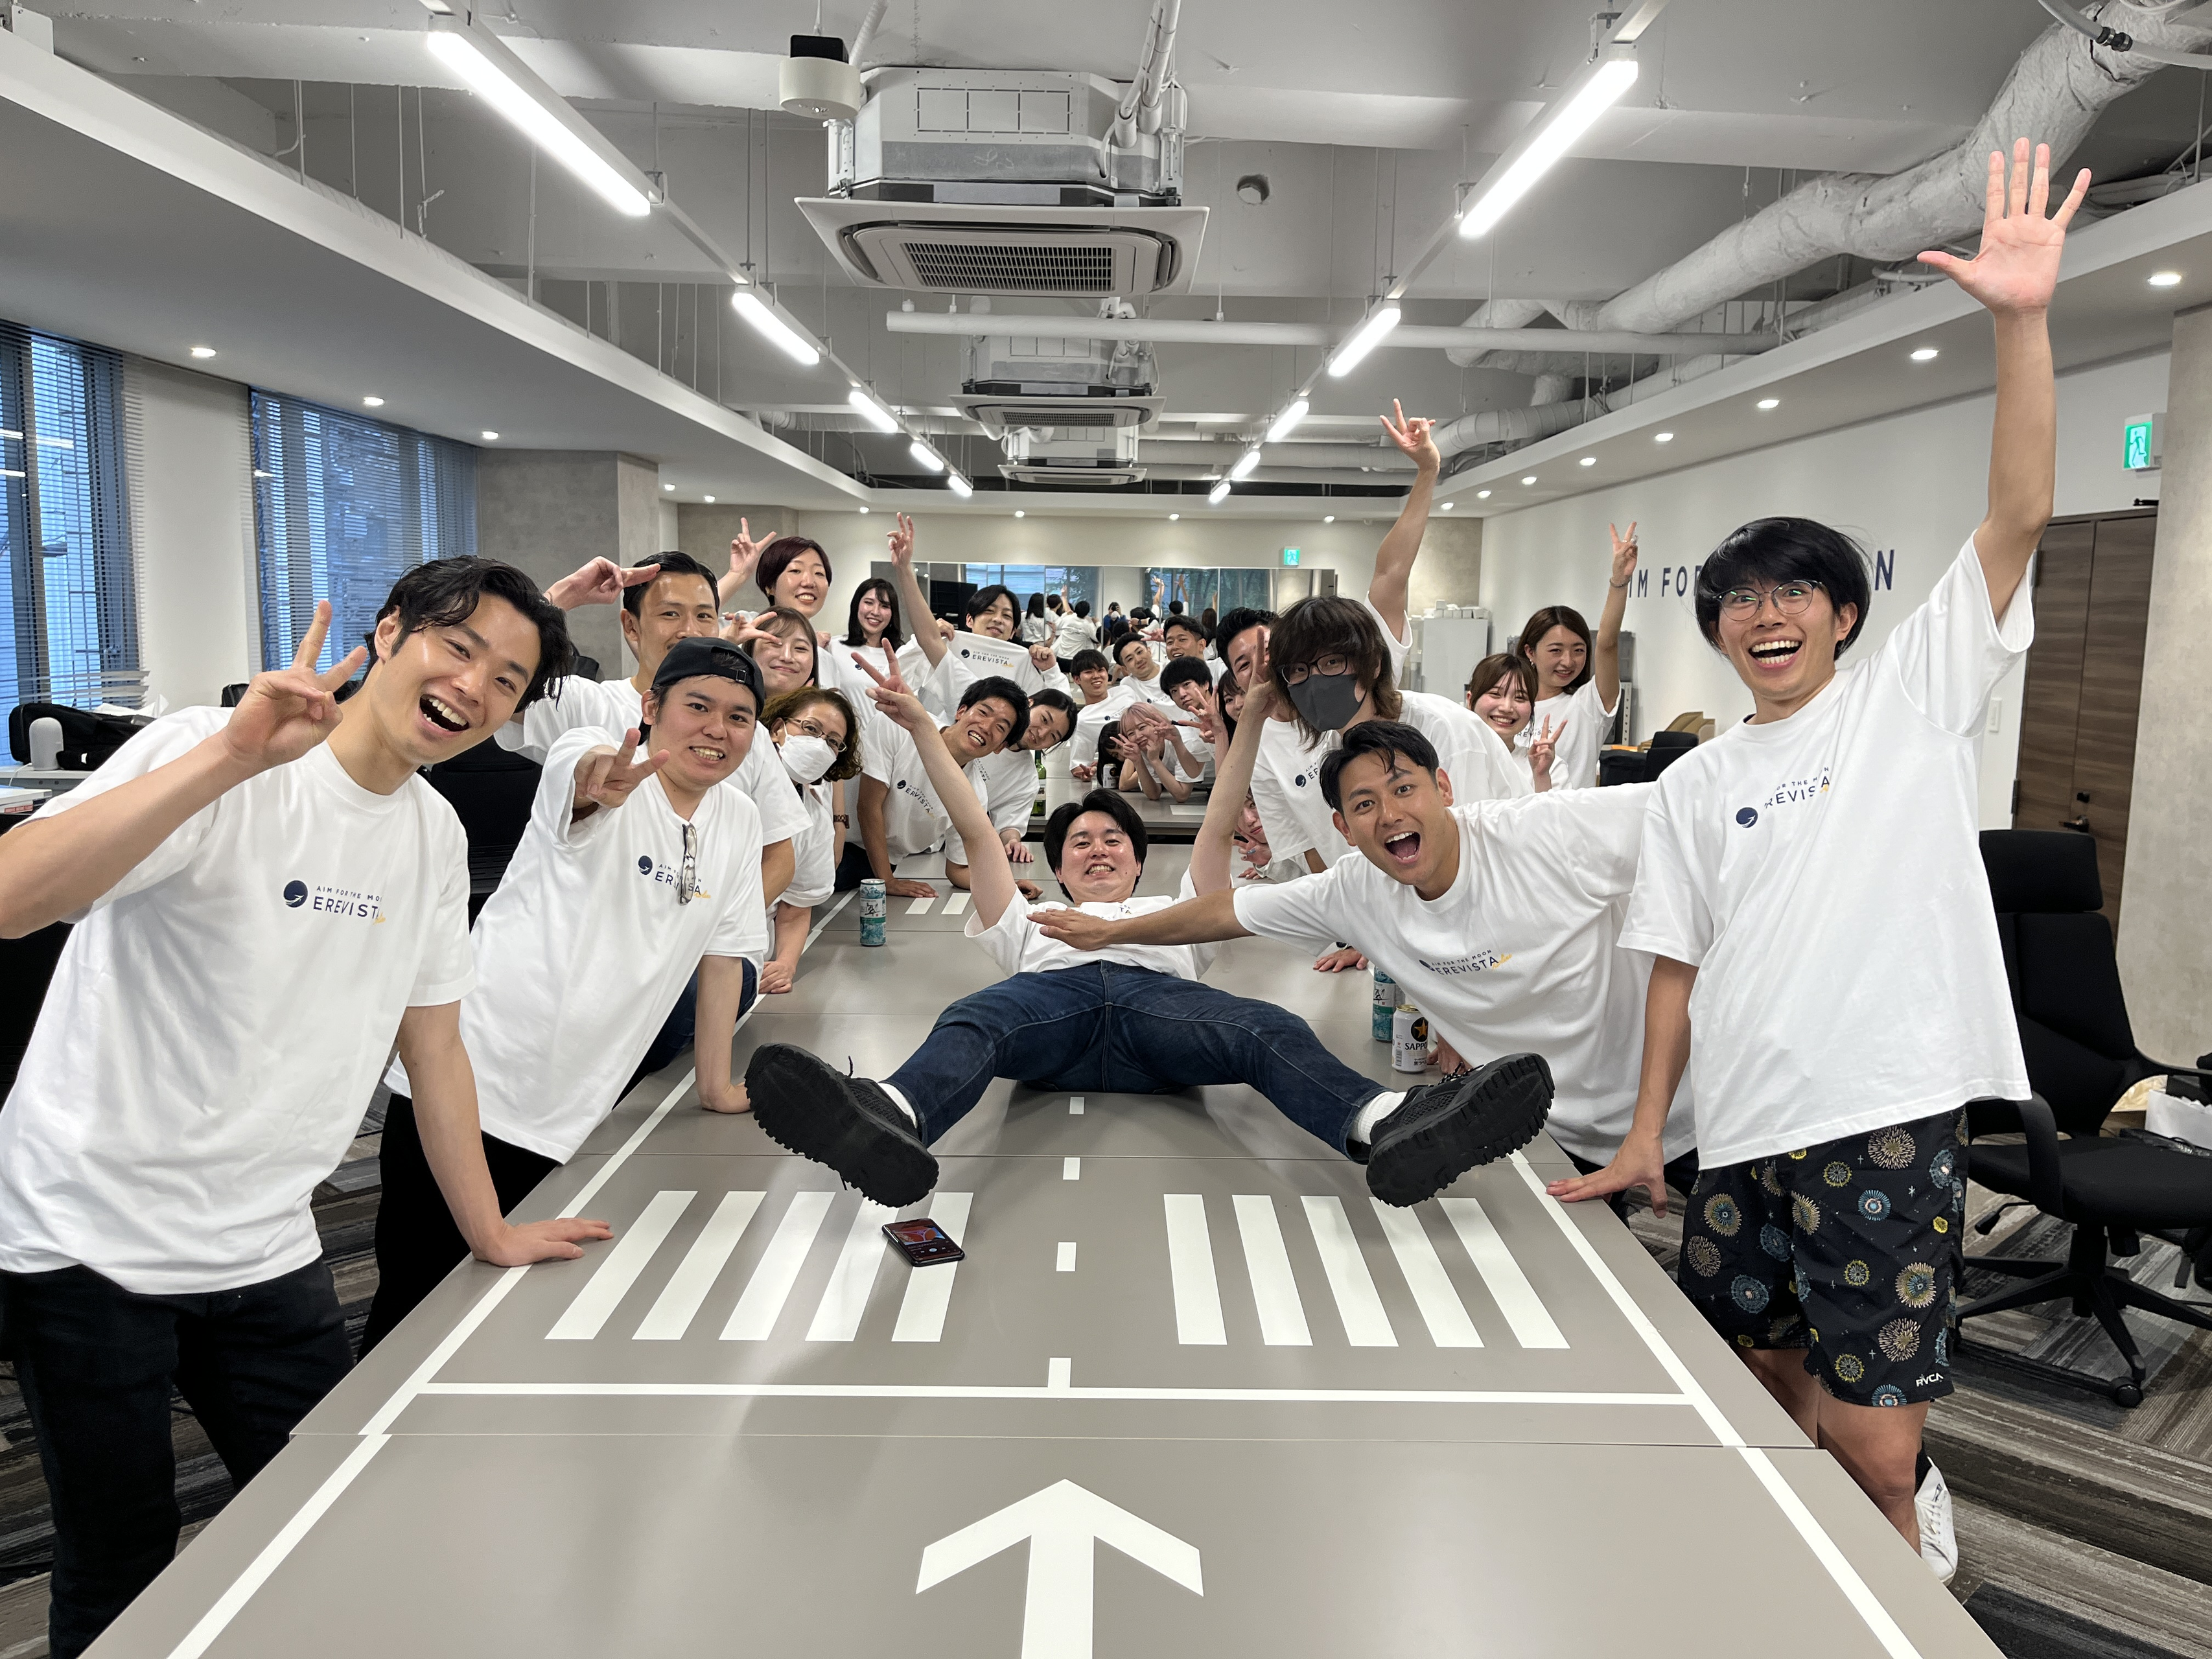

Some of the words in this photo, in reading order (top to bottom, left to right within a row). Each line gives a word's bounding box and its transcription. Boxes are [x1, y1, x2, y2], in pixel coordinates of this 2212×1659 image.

[1629, 569, 1648, 597] IM
[972, 654, 1008, 666] EREVISTA
[313, 896, 379, 920] EREVIST
[1471, 949, 1491, 960] MOON
[1435, 956, 1499, 975] EREVISTA
[1915, 1372, 1944, 1387] RVCA
